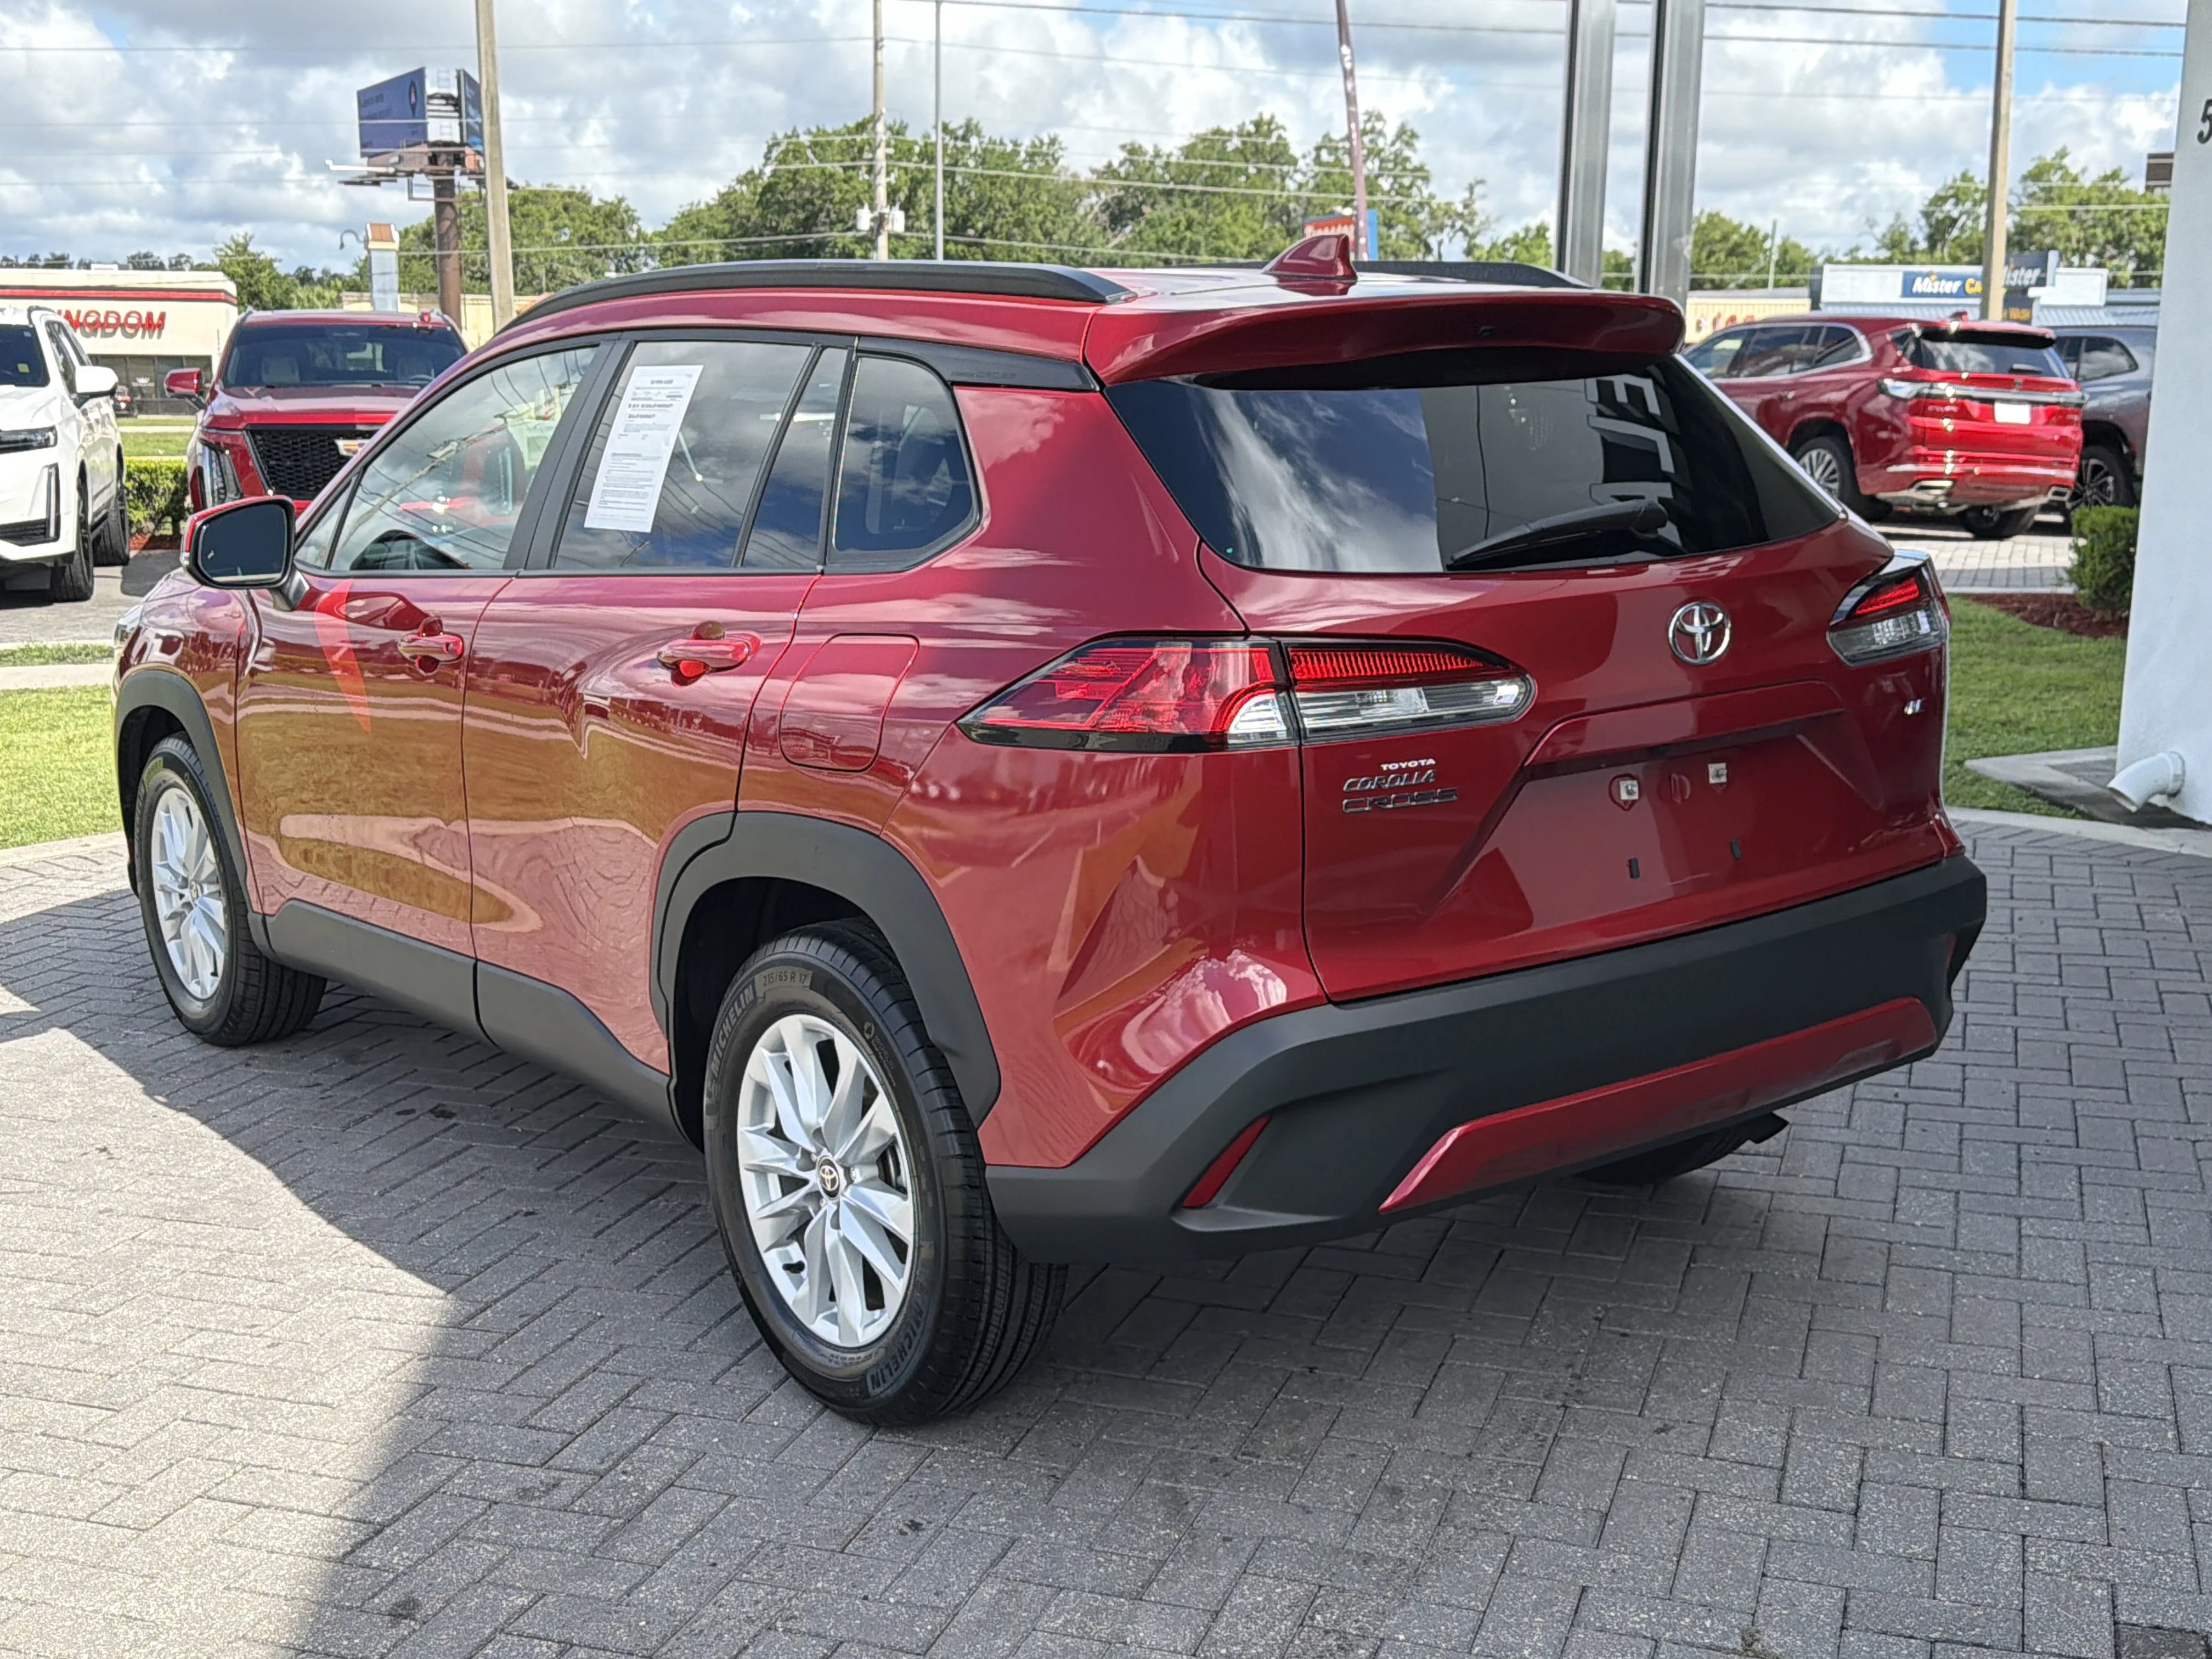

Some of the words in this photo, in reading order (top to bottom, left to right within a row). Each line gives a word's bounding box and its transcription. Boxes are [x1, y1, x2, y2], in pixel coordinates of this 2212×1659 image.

[1912, 276, 1962, 294] Mister
[57, 309, 166, 332] NGDOM
[1380, 758, 1436, 771] TOYOTA
[1343, 769, 1436, 792] COROLLA
[1342, 787, 1458, 813] CROSS
[790, 970, 795, 981] R
[799, 972, 808, 984] 17
[711, 984, 755, 1078] MICHELIN
[870, 1300, 924, 1392] MICHELIN
